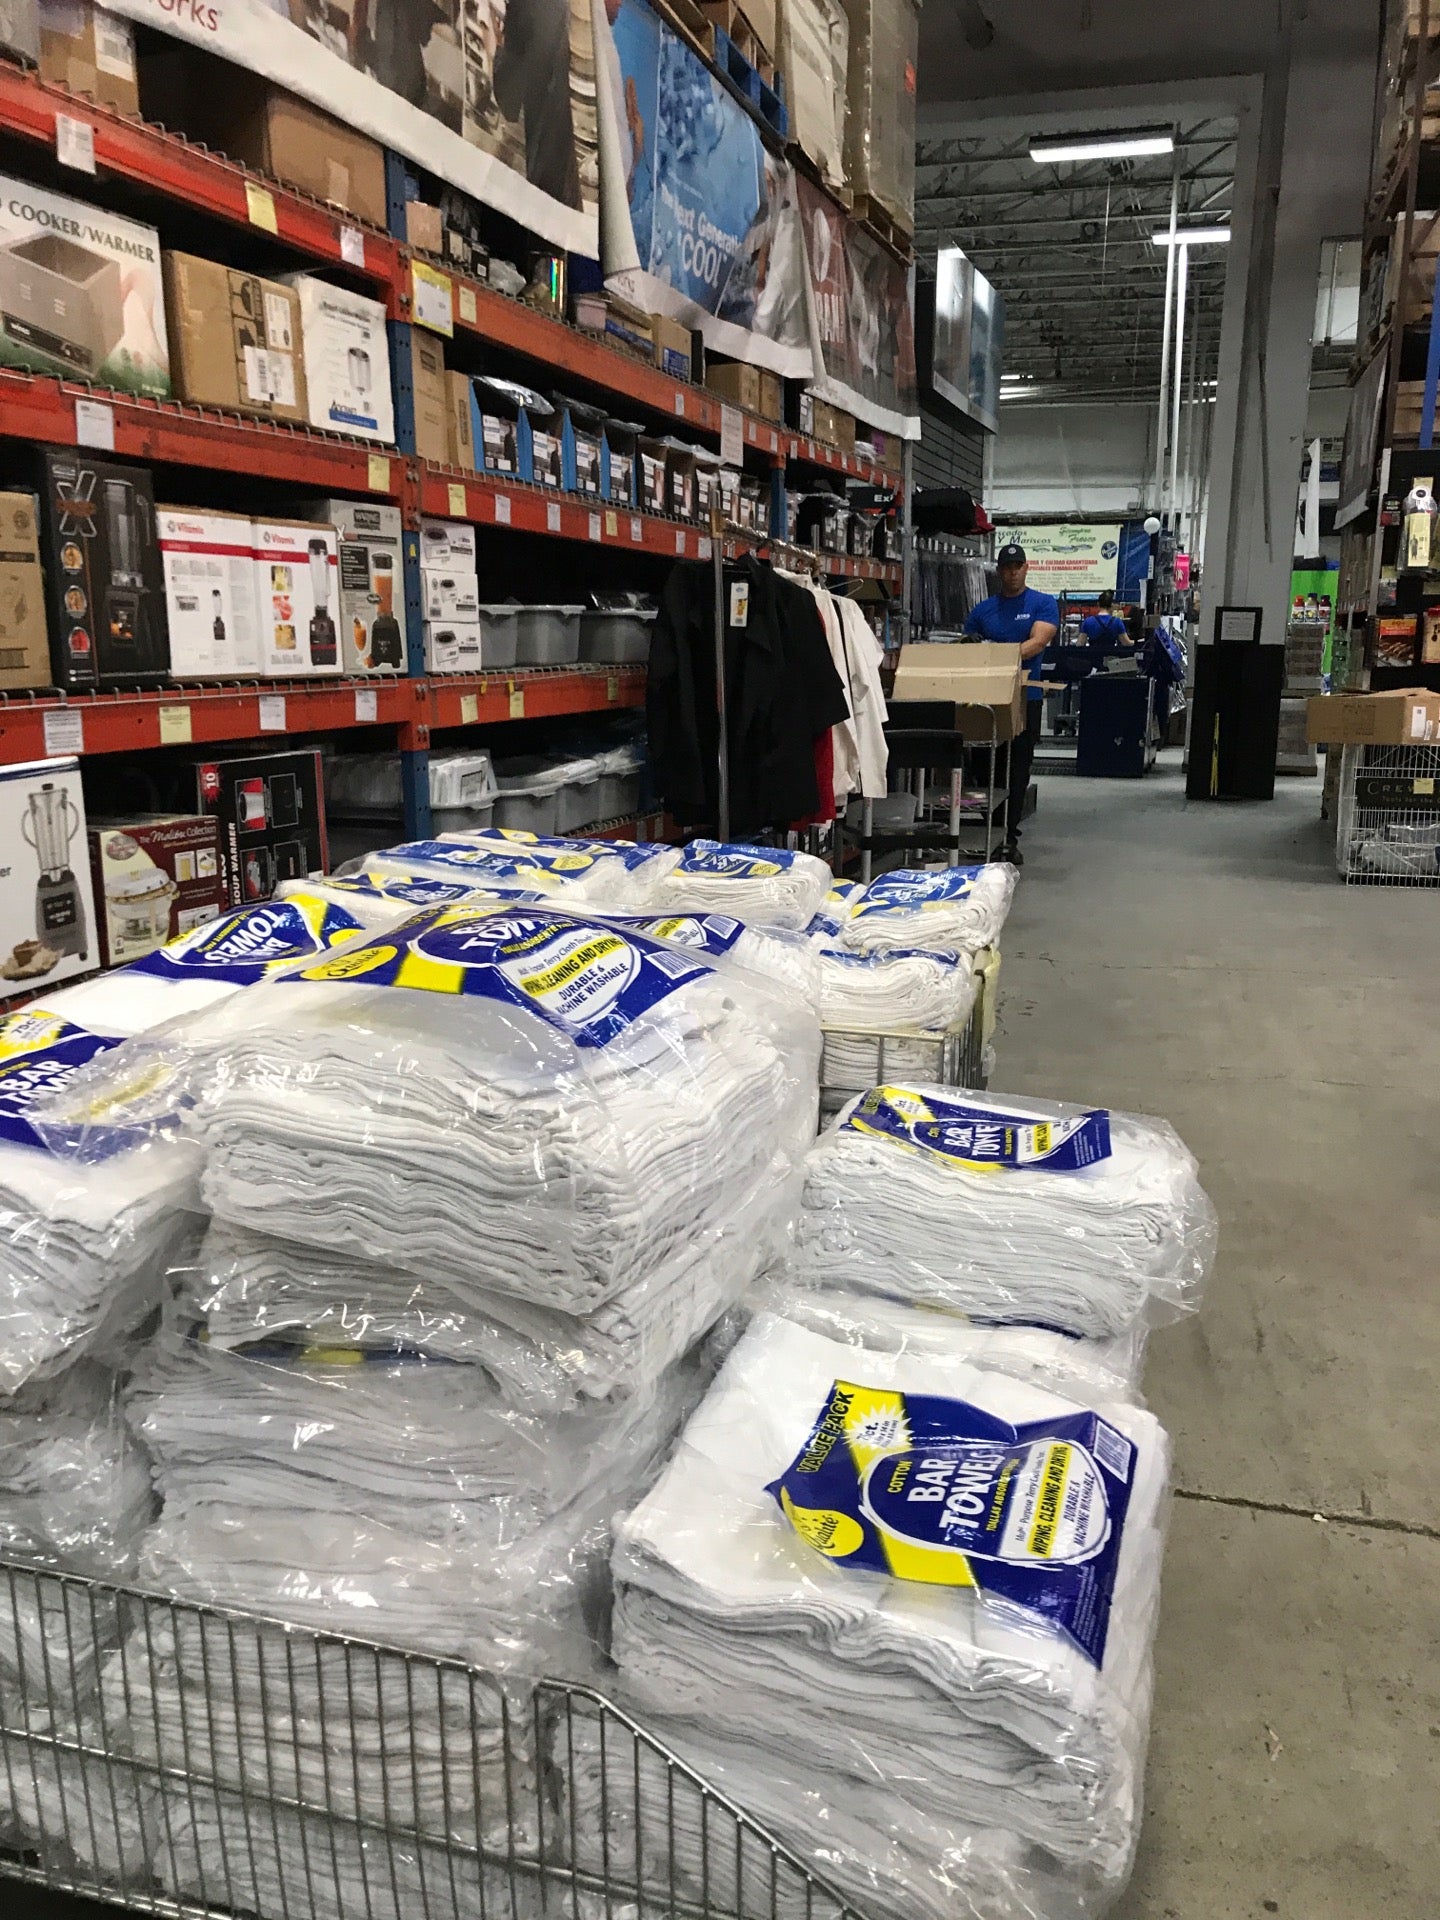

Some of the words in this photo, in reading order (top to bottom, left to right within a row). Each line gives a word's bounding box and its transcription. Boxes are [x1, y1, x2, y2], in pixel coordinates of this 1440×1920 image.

[9, 200, 156, 264] COOKER/WARMER
[228, 822, 239, 872] WARMER
[204, 909, 284, 963] TOWELS
[558, 940, 577, 957] Cloth
[576, 946, 597, 965] AND
[558, 968, 599, 1001] DURABLE
[585, 962, 630, 996] WASHABLE
[971, 1123, 1003, 1156] TOWE
[796, 1432, 835, 1473] VALUE
[824, 1391, 855, 1435] PACK
[887, 1460, 913, 1493] COTTON
[906, 1458, 959, 1501] BAR
[938, 1451, 1006, 1529] TOWELS
[1047, 1465, 1065, 1485] AND
[1079, 1471, 1096, 1512] WASHABLE
[1038, 1482, 1062, 1523] CLEANING
[1063, 1486, 1081, 1522] DURABLE
[1073, 1511, 1090, 1547] MACHINE
